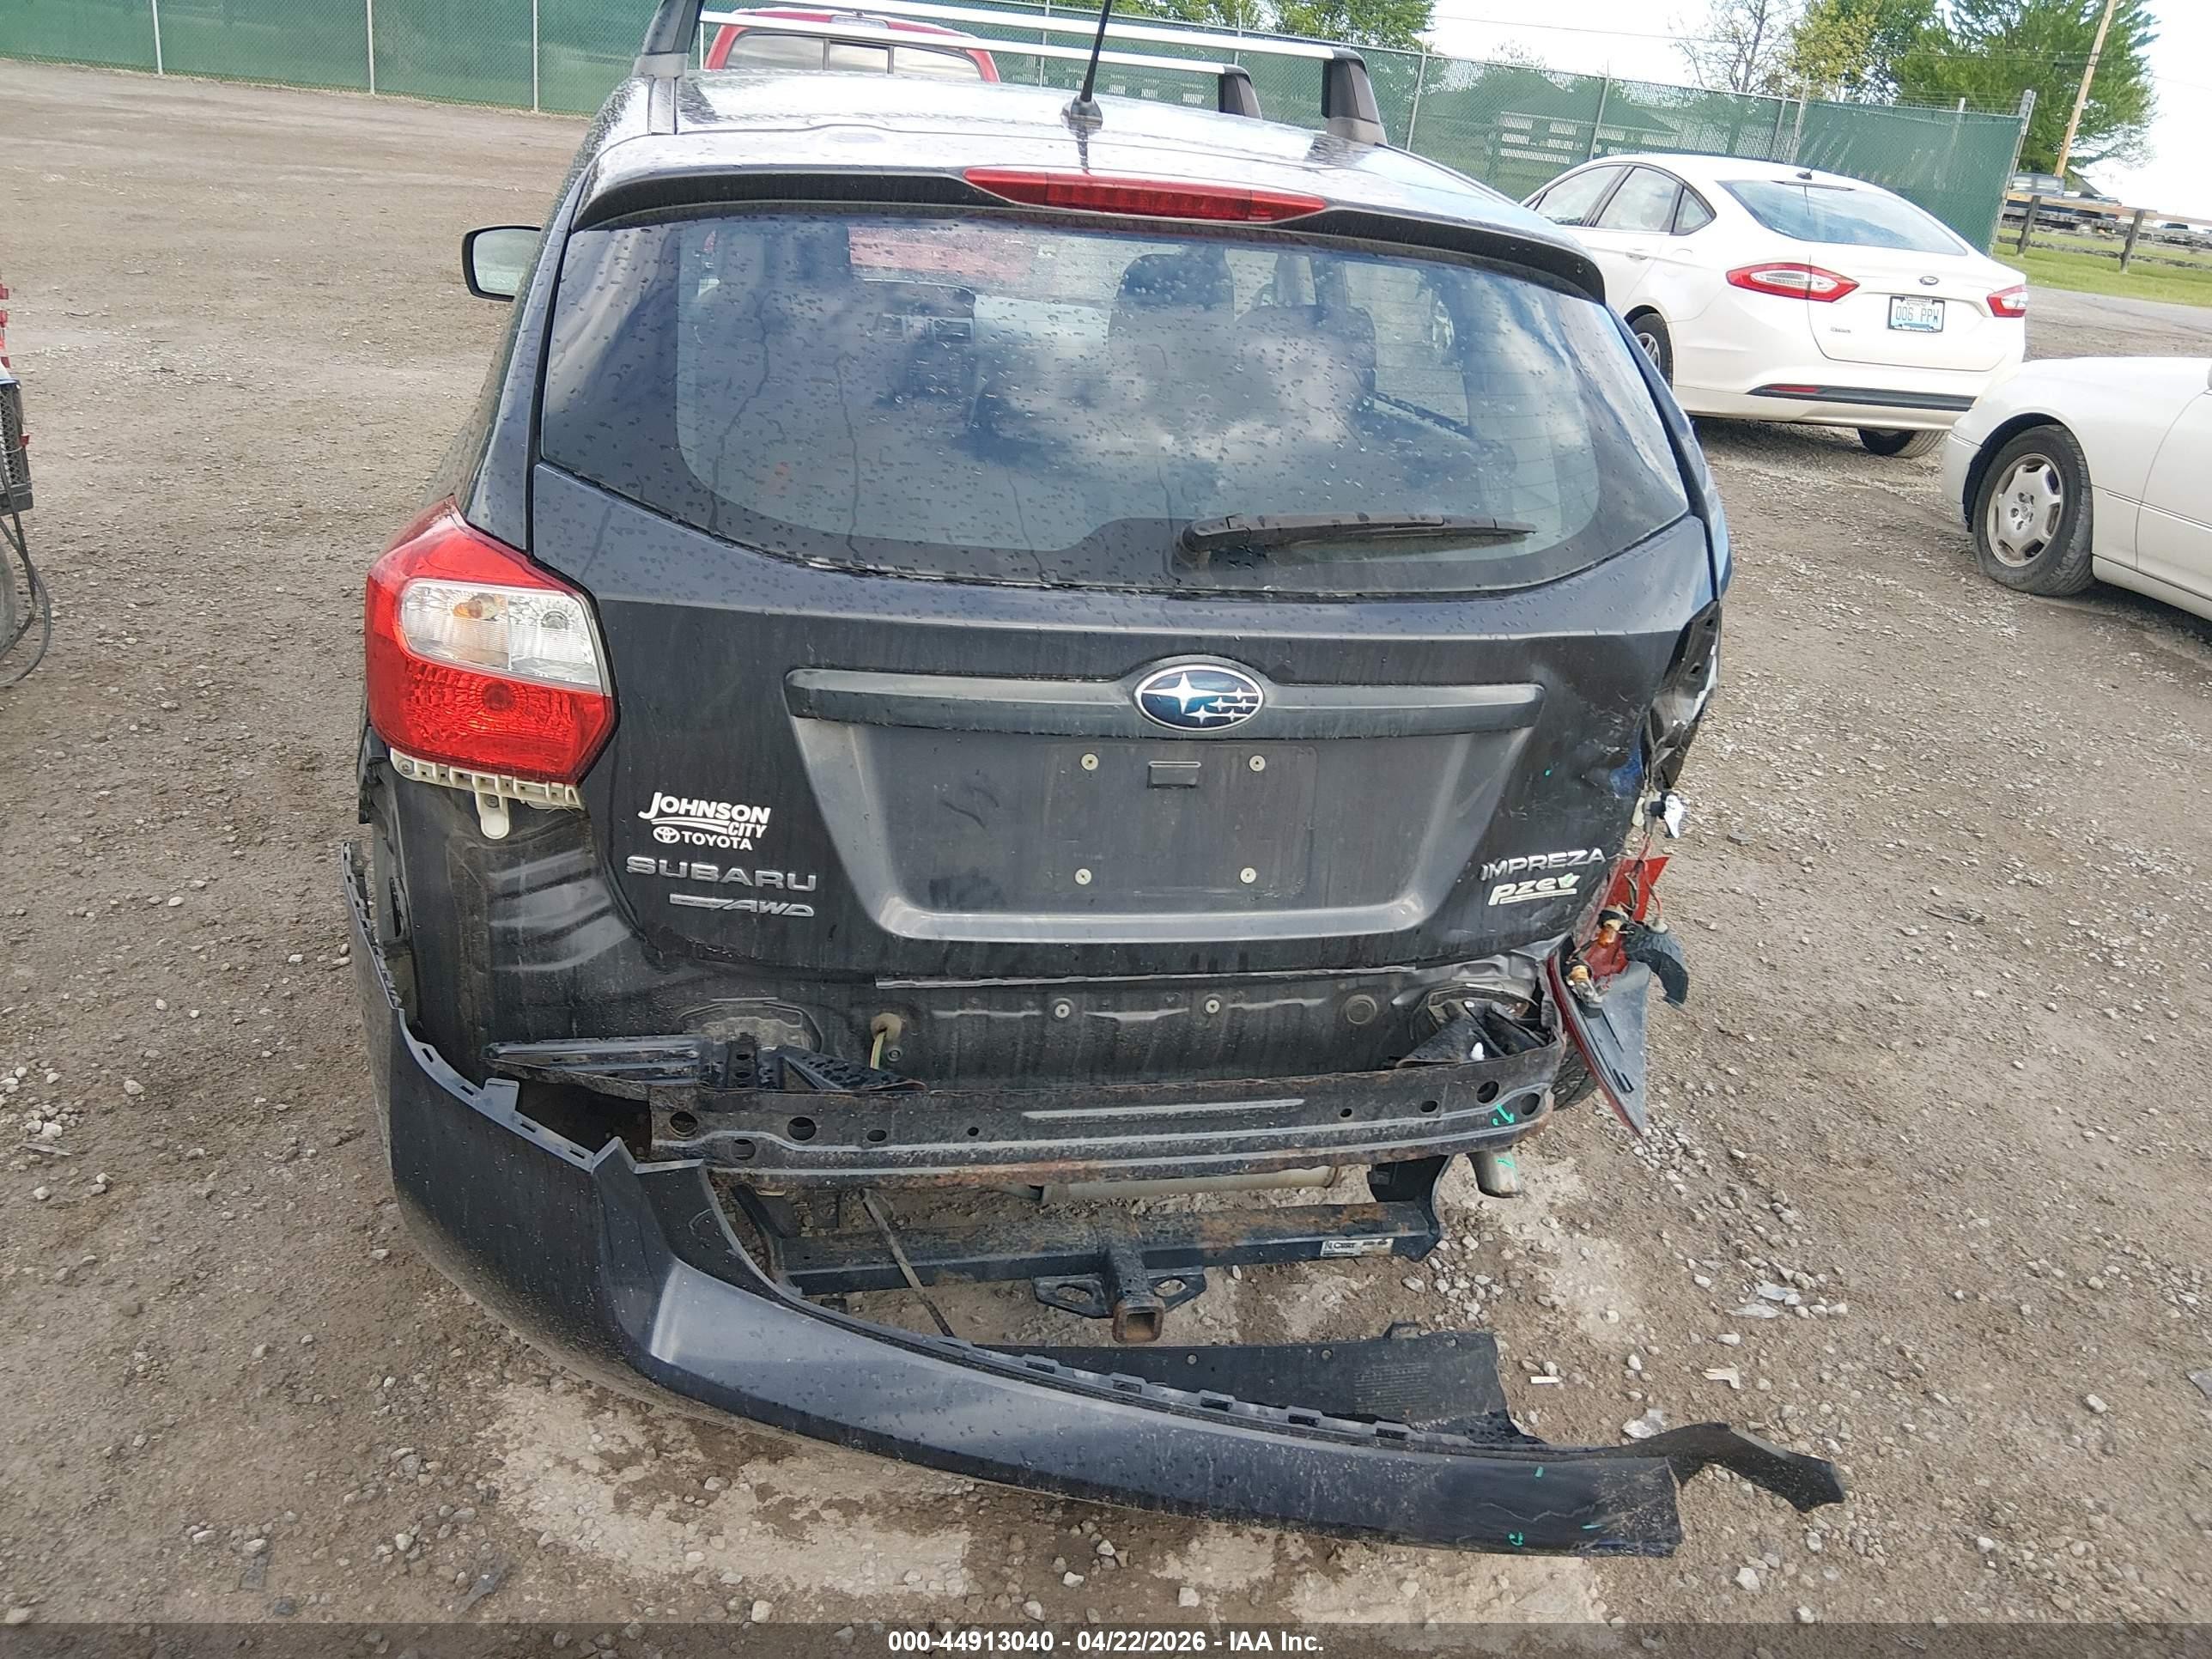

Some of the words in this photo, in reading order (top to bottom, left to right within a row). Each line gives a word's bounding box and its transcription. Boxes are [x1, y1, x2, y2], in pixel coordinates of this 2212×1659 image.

[638, 792, 771, 824] JOHNSON
[681, 830, 753, 851] TOYOTA
[728, 822, 768, 839] CITY
[626, 855, 817, 891] SUBARU
[1480, 848, 1606, 881] IMPREZA
[722, 899, 815, 917] AWD
